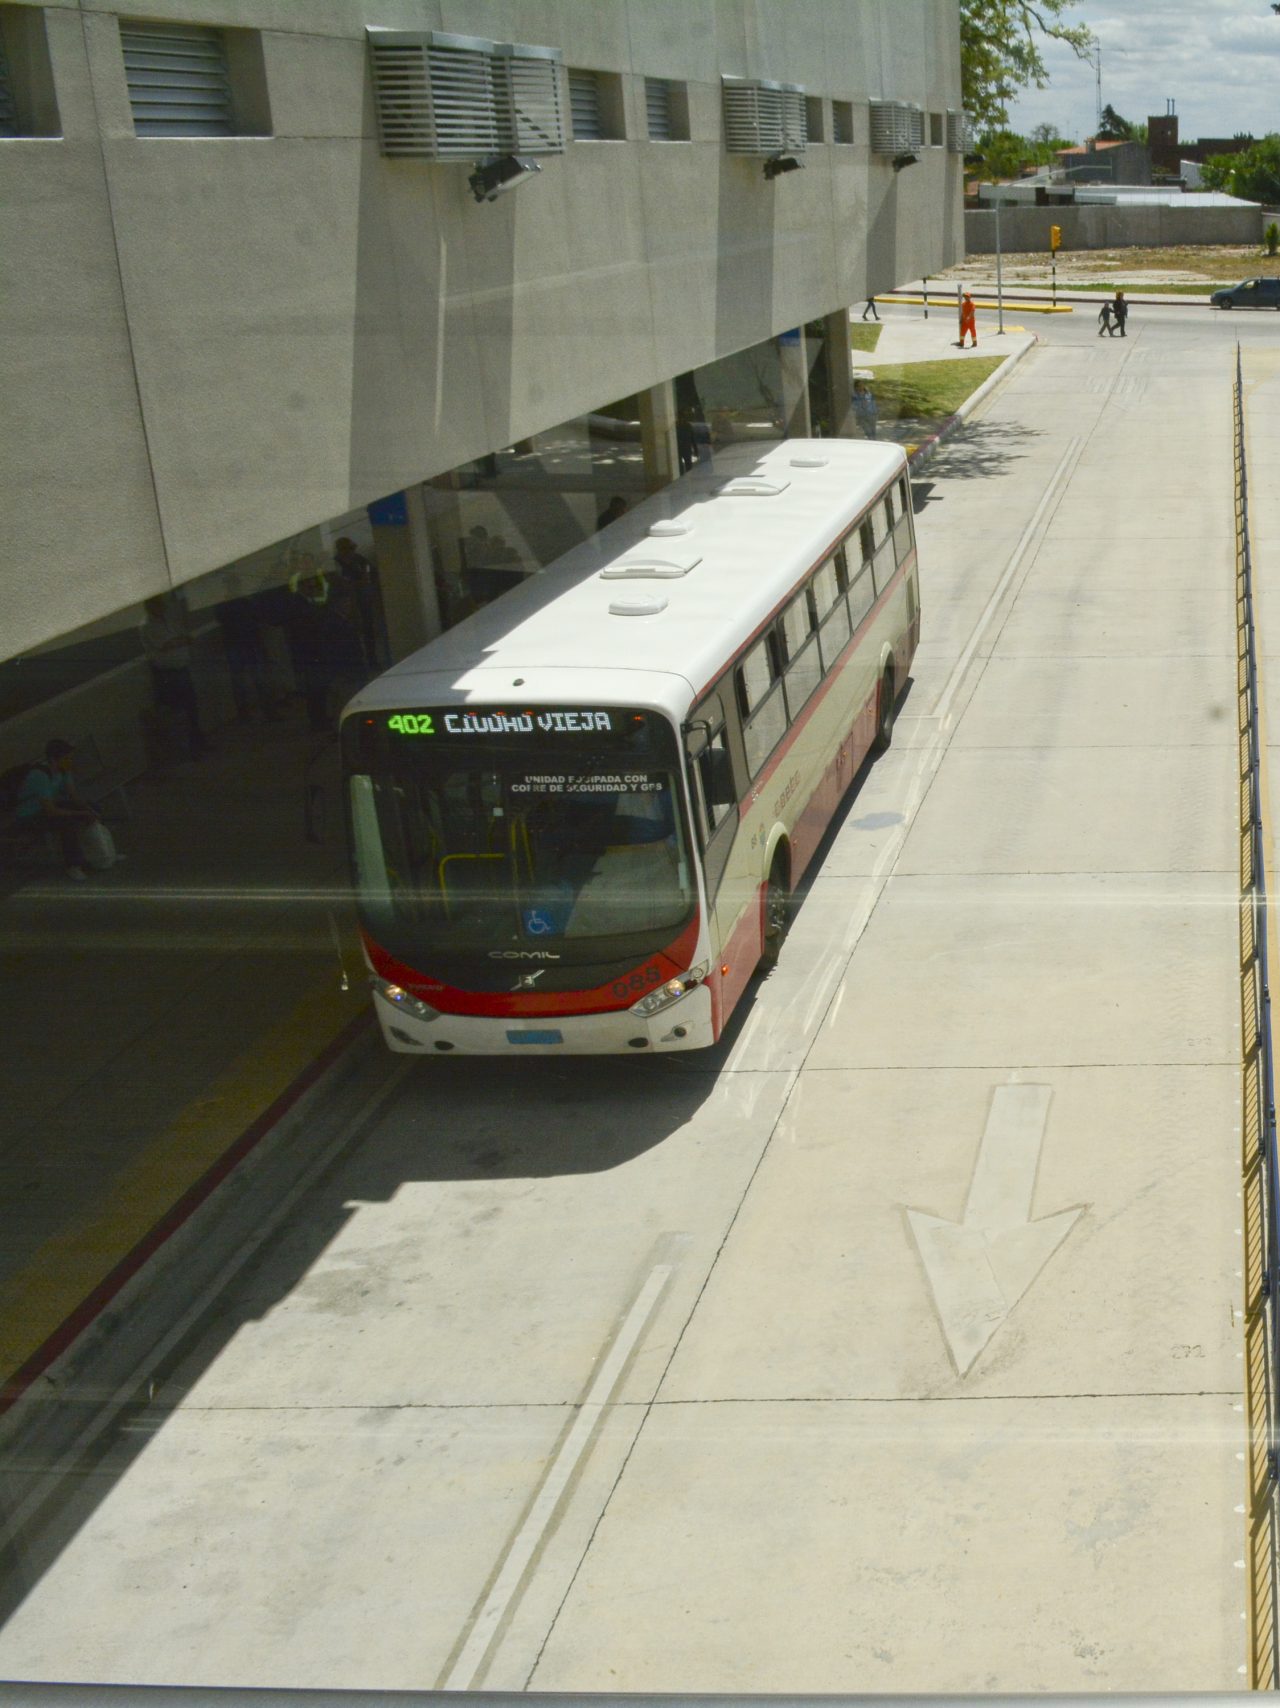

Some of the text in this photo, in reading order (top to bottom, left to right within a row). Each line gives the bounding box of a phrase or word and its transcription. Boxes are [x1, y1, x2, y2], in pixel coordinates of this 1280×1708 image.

[388, 714, 435, 734] 402
[537, 711, 612, 731] VIEJA
[525, 775, 566, 784] UNIDAD
[624, 774, 648, 783] CON
[549, 784, 563, 793] DE
[630, 783, 637, 792] Y
[487, 951, 560, 960] COMIL
